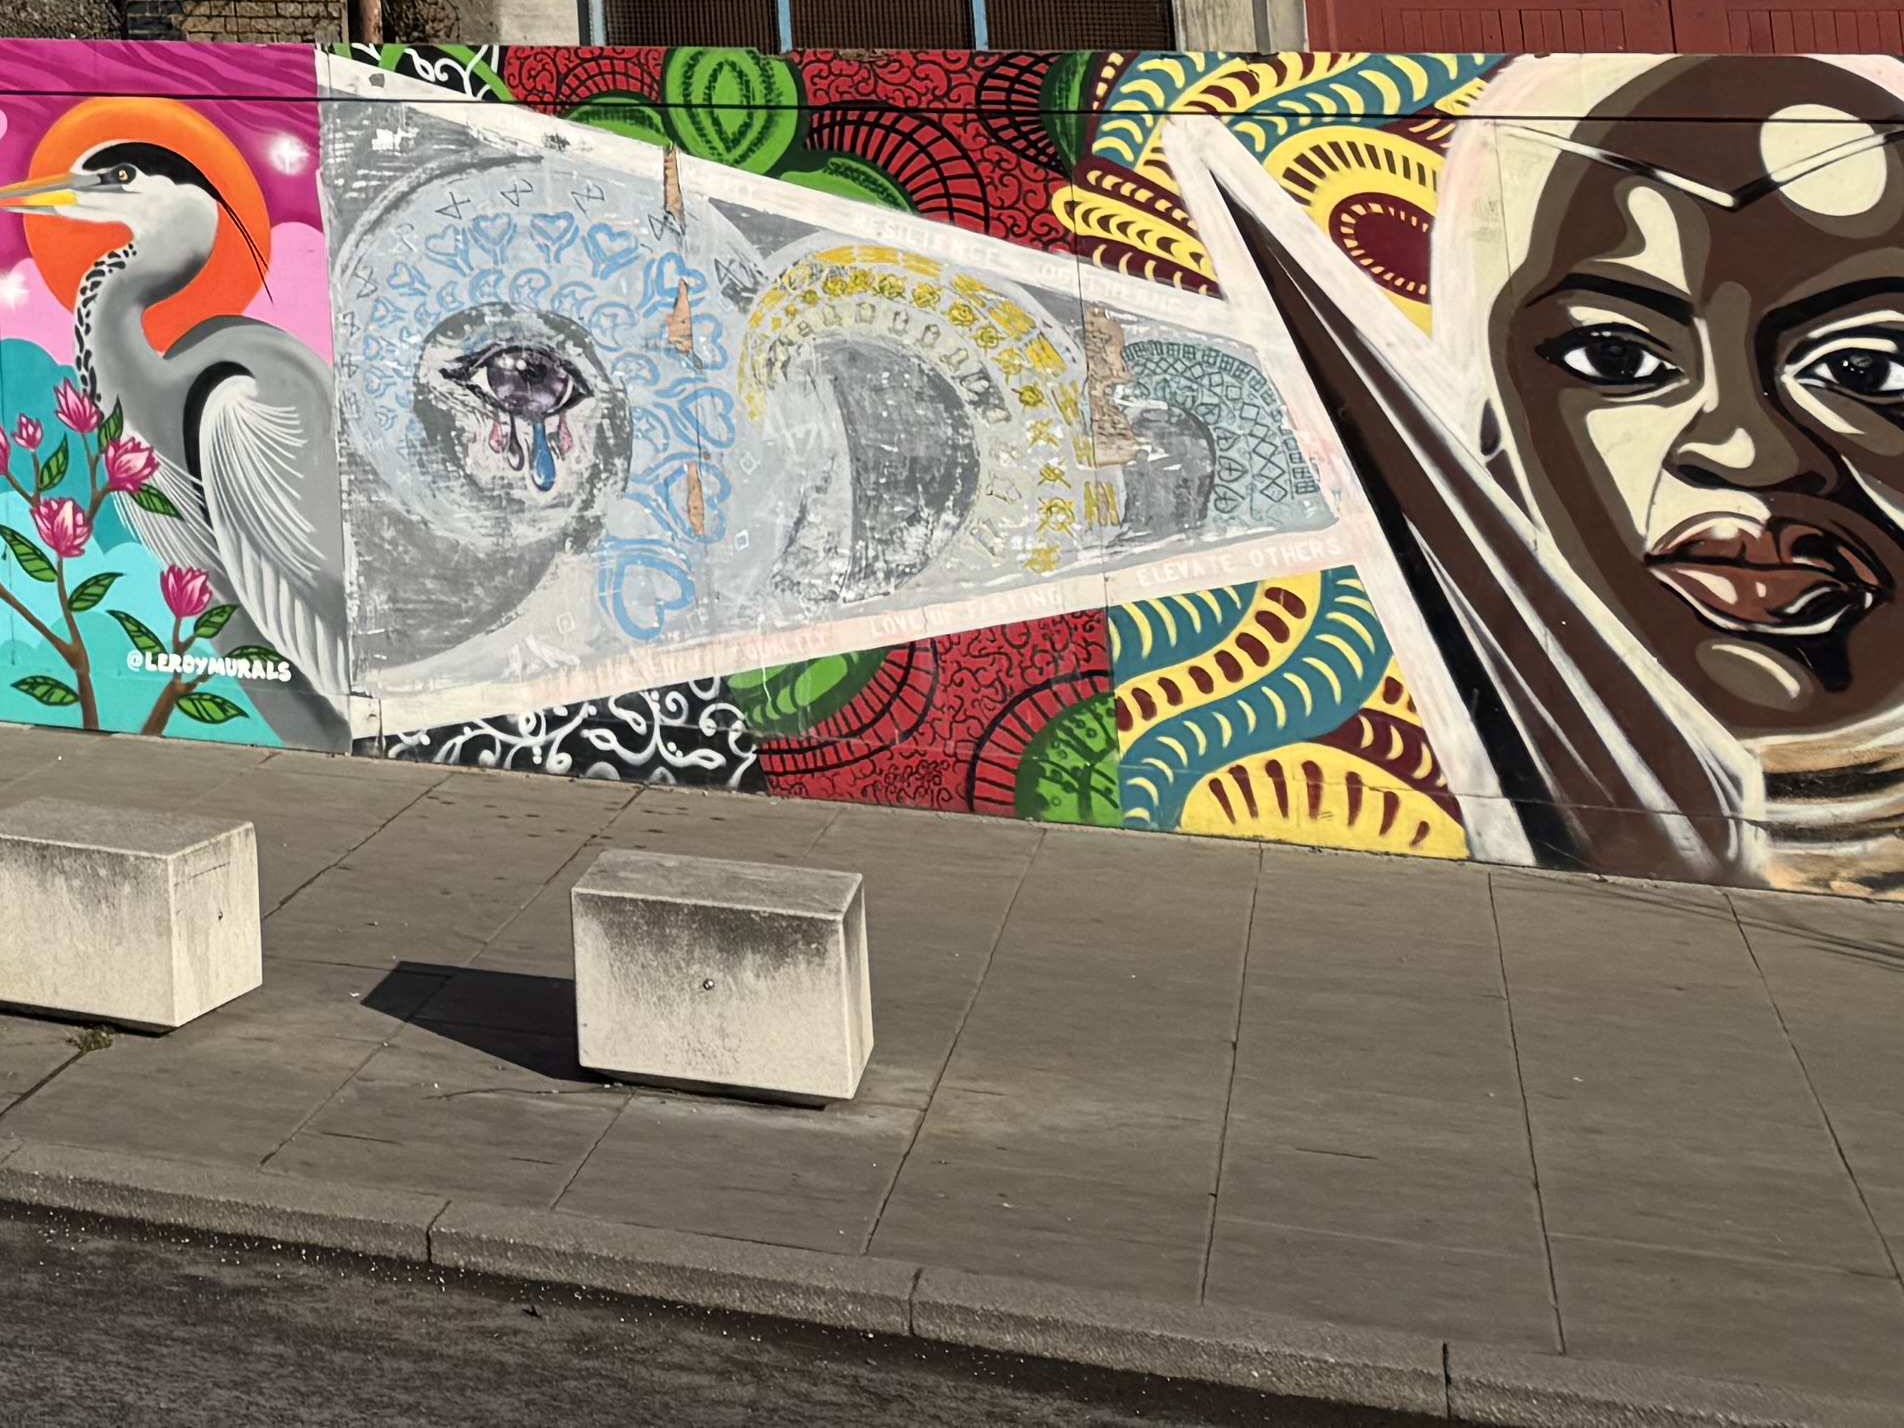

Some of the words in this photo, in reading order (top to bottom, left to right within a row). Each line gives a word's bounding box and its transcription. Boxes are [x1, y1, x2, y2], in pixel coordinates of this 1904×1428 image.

[1136, 554, 1237, 587] ELEVATE
[1249, 538, 1343, 568] OTHERS
[869, 614, 921, 637] LOVE
[127, 650, 291, 682] @LEROYMURALS
